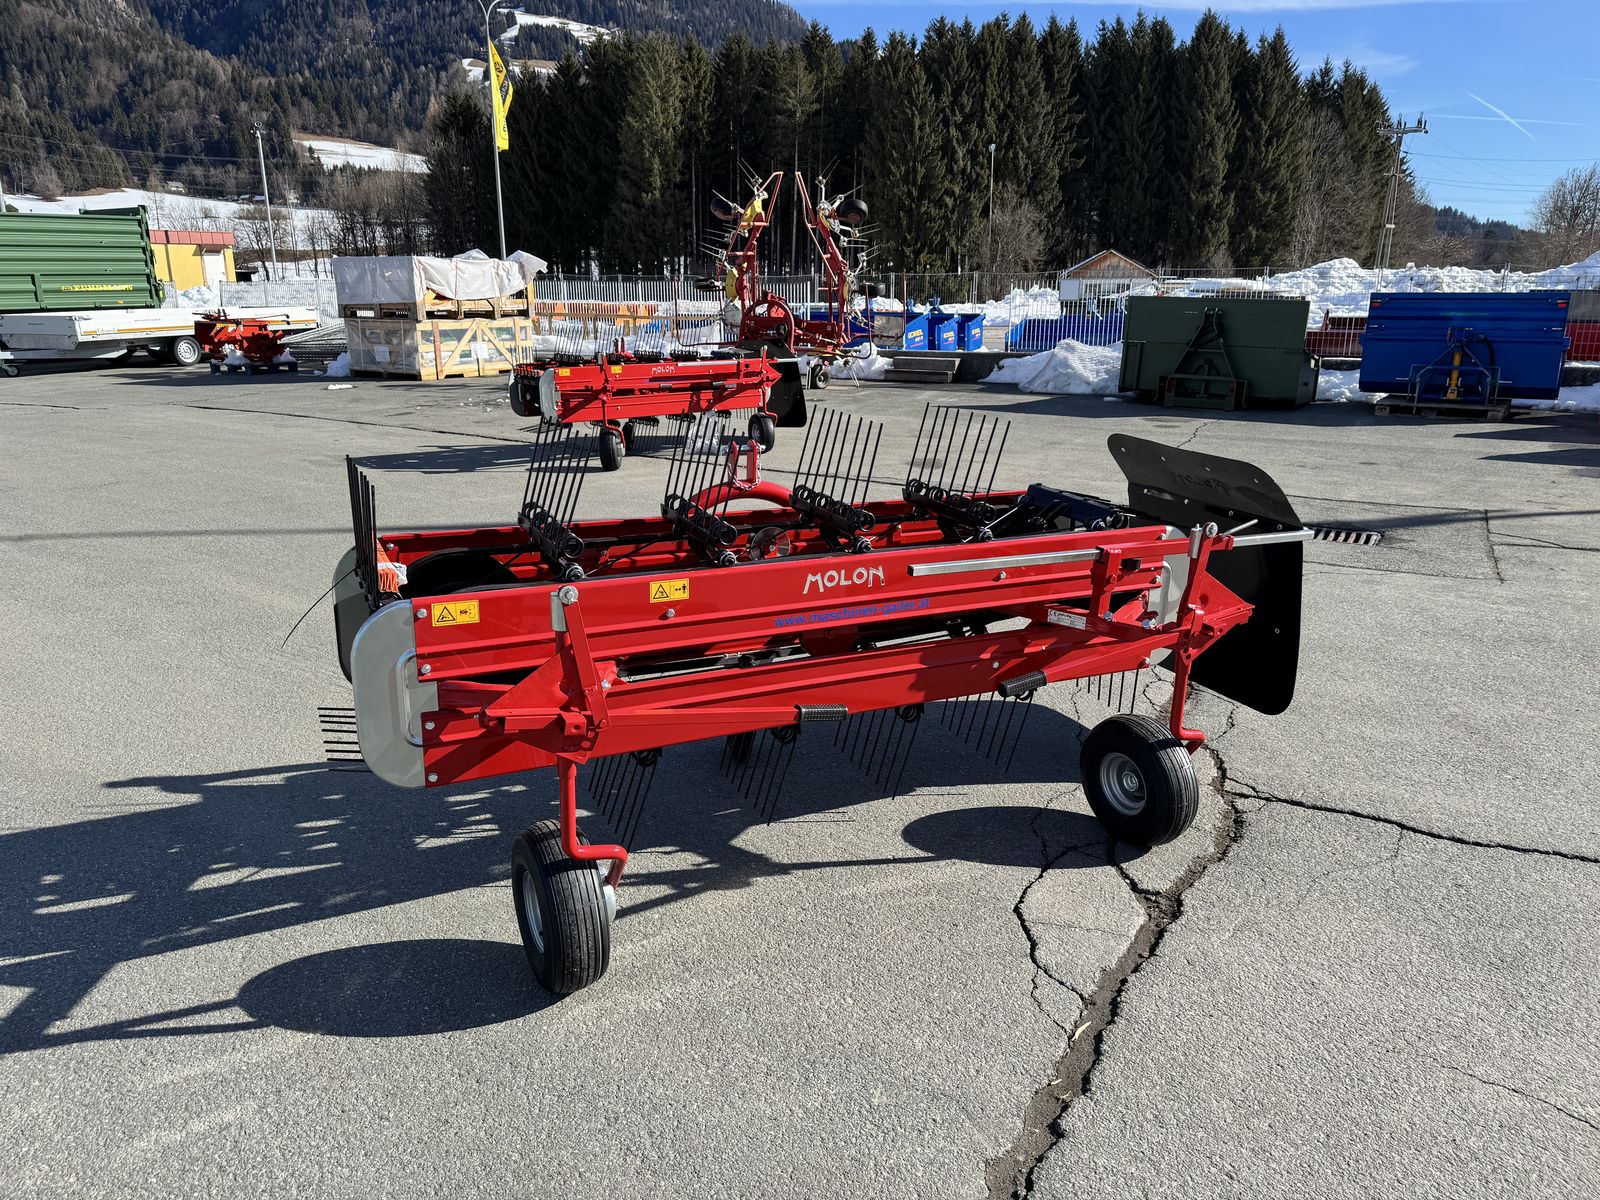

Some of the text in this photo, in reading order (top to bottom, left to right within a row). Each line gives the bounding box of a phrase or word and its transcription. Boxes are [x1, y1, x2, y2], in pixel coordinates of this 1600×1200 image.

[651, 365, 675, 375] MOLON
[803, 565, 885, 595] MOLON
[774, 598, 930, 628] www.maschinen-gailer.at
